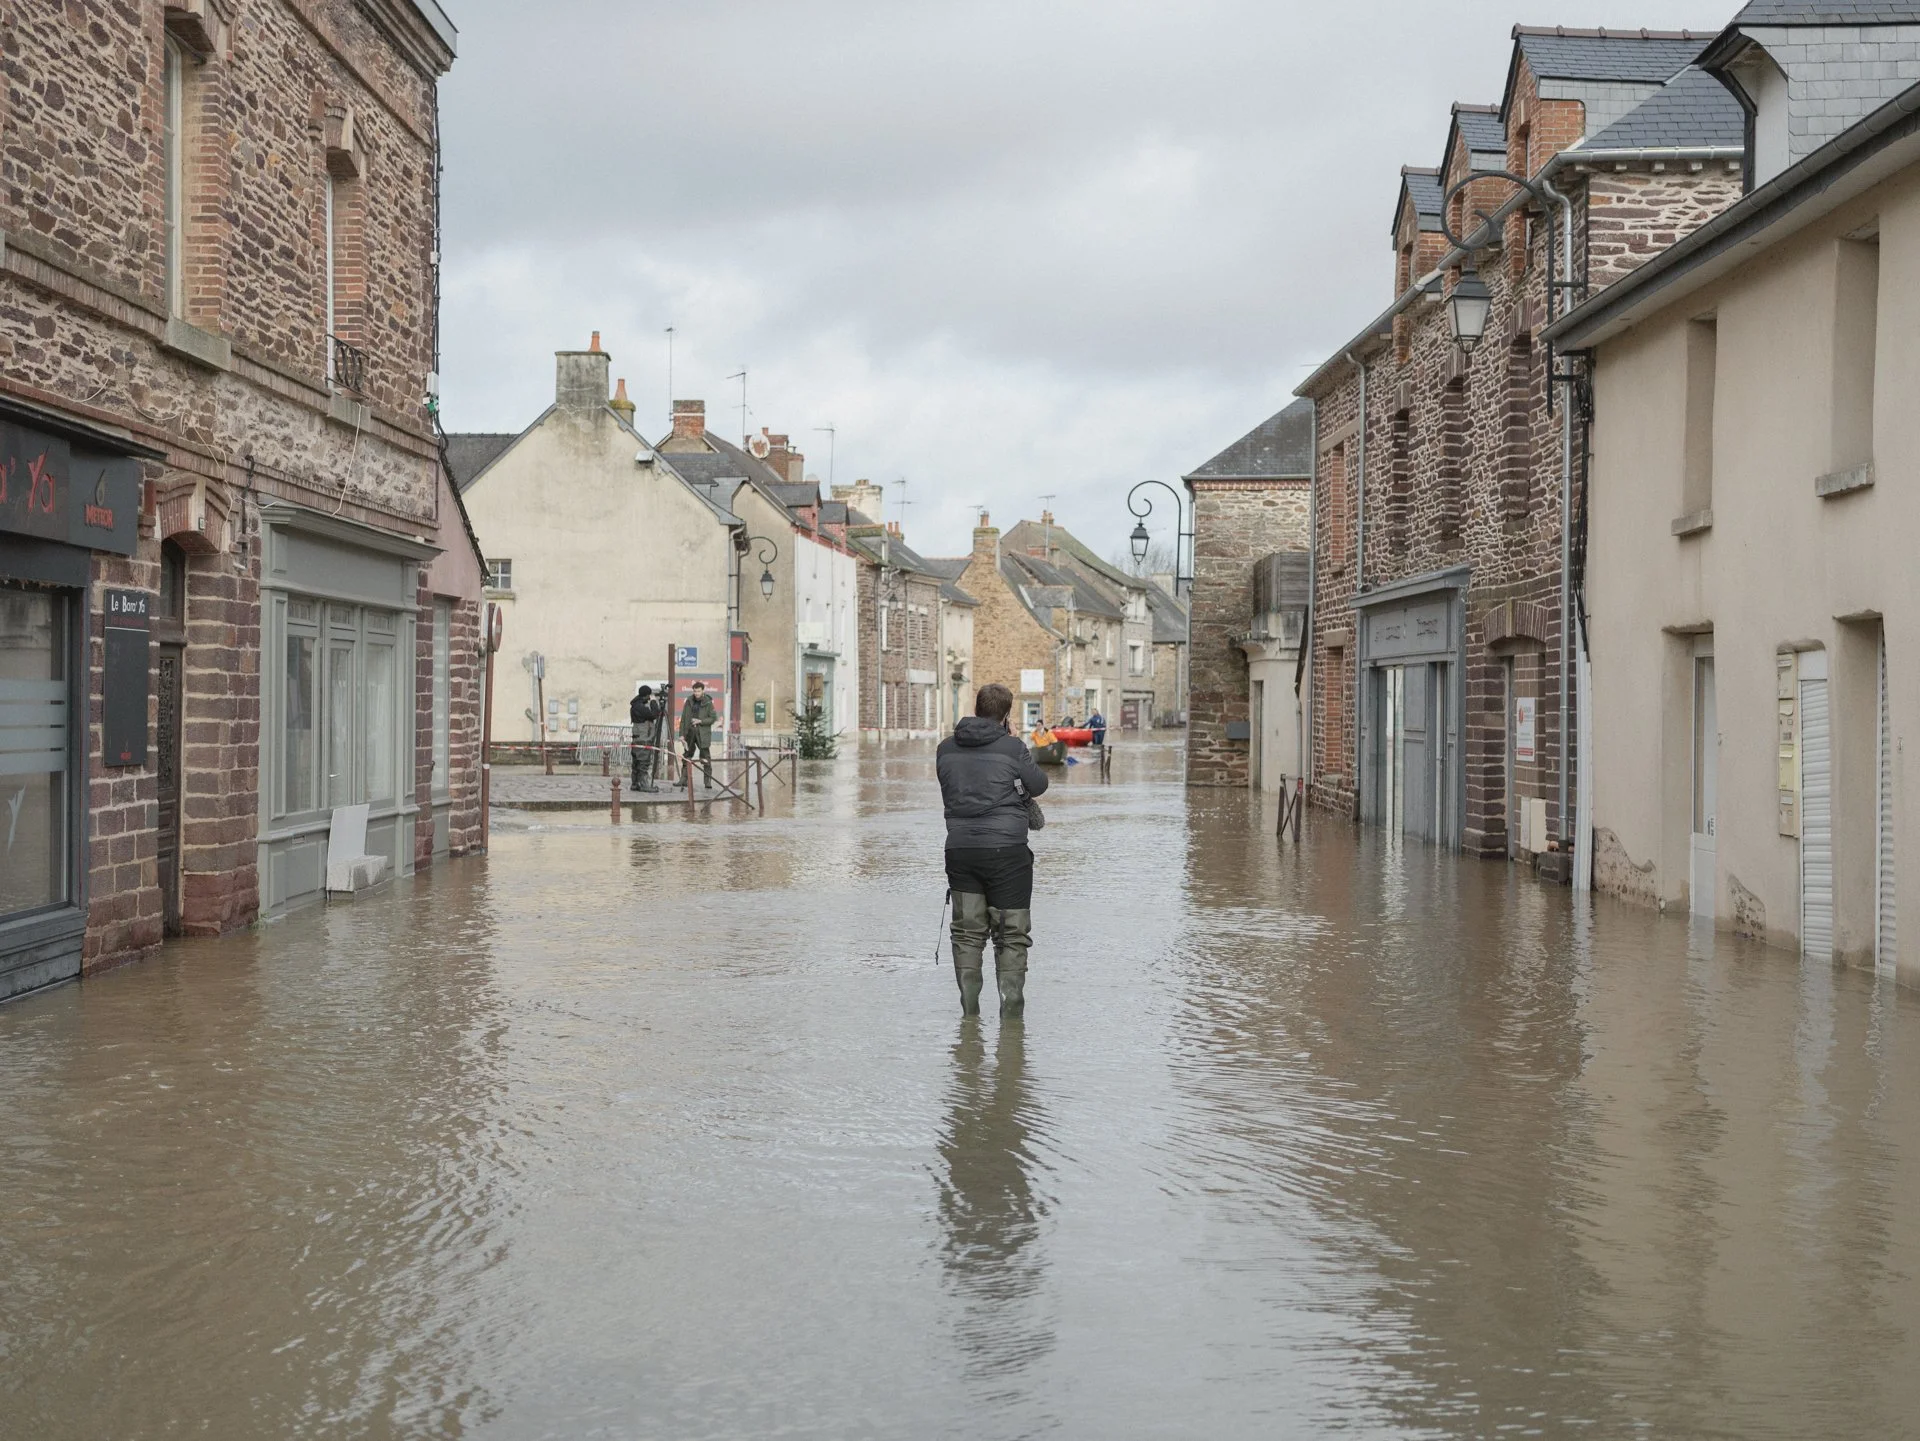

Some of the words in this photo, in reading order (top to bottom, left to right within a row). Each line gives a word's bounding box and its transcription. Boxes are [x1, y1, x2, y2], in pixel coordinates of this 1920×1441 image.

[28, 450, 55, 513] Ya
[111, 594, 119, 612] Le
[678, 648, 688, 662] P
